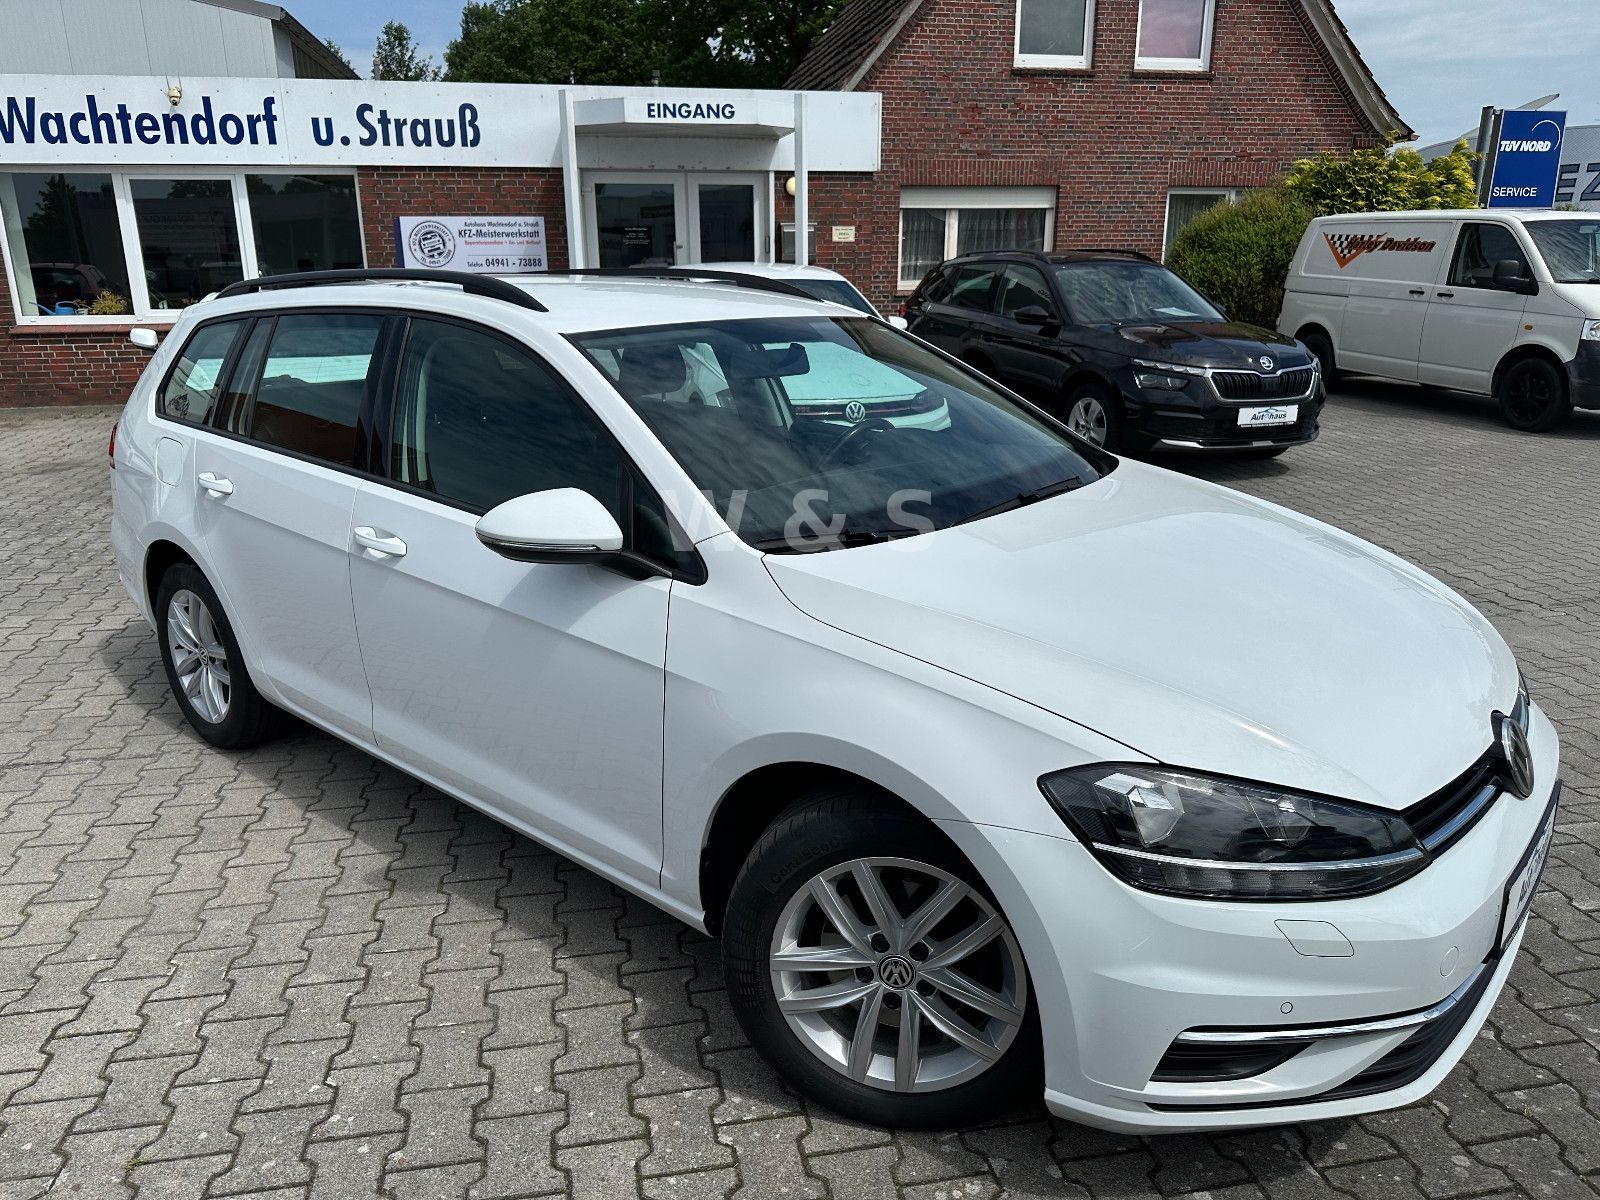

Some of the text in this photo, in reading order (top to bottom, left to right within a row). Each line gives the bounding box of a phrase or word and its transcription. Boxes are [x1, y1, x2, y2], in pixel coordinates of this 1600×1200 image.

[646, 102, 736, 120] EINGANG
[0, 95, 278, 145] Wachtendorf
[1520, 141, 1552, 152] NORD
[1492, 186, 1538, 197] SERVICE
[458, 228, 540, 239] KFZ-Meisterwerkstatt
[1377, 237, 1437, 252] Davidson
[485, 258, 509, 267] 04941
[518, 257, 542, 267] 73888
